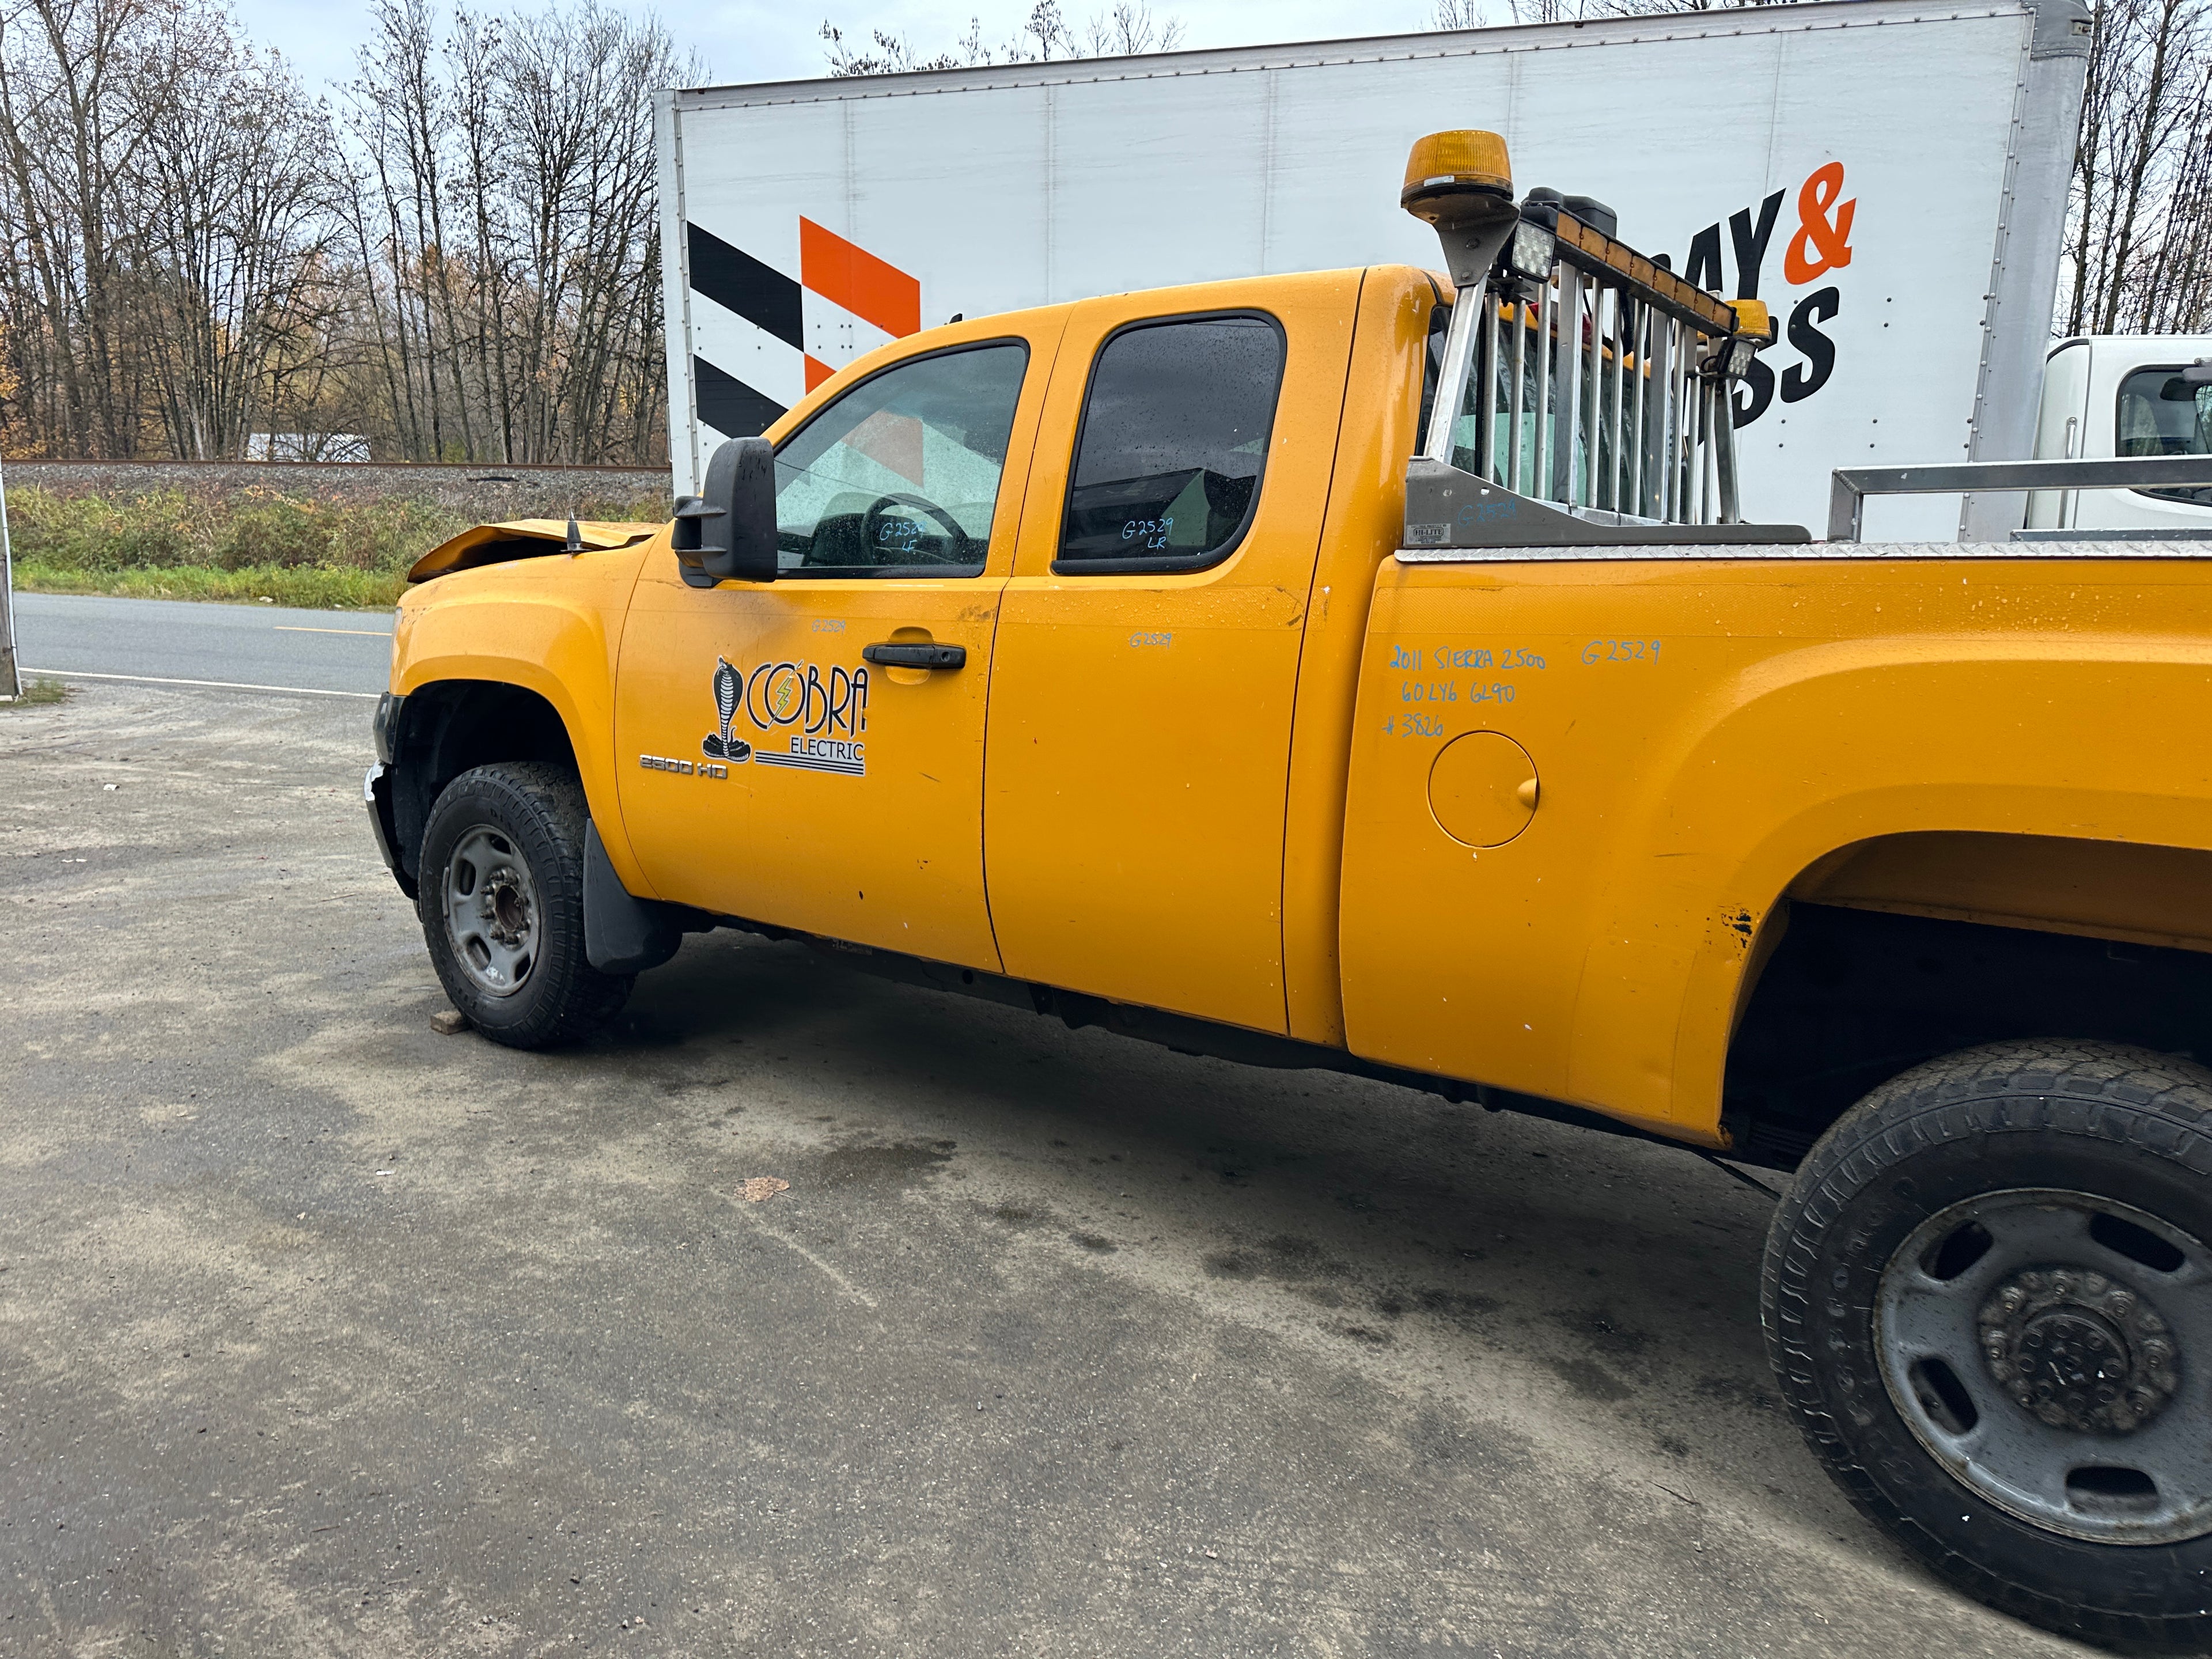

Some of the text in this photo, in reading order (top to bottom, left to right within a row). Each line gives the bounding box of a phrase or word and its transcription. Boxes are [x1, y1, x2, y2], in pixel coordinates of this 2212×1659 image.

[1784, 161, 1857, 285] &
[879, 520, 927, 541] G2529
[1122, 517, 1174, 539] G2529
[1415, 528, 1442, 536] HI-LITE
[1147, 536, 1166, 550] LR
[811, 618, 846, 637] G2529
[1130, 631, 1172, 650] G2529
[1389, 644, 1546, 671] 2011 SIERRA 2500
[1581, 639, 1661, 666] G2529
[747, 660, 869, 738] COBRA
[790, 736, 864, 761] ELECTRIC
[639, 753, 728, 779] 2500 HD
